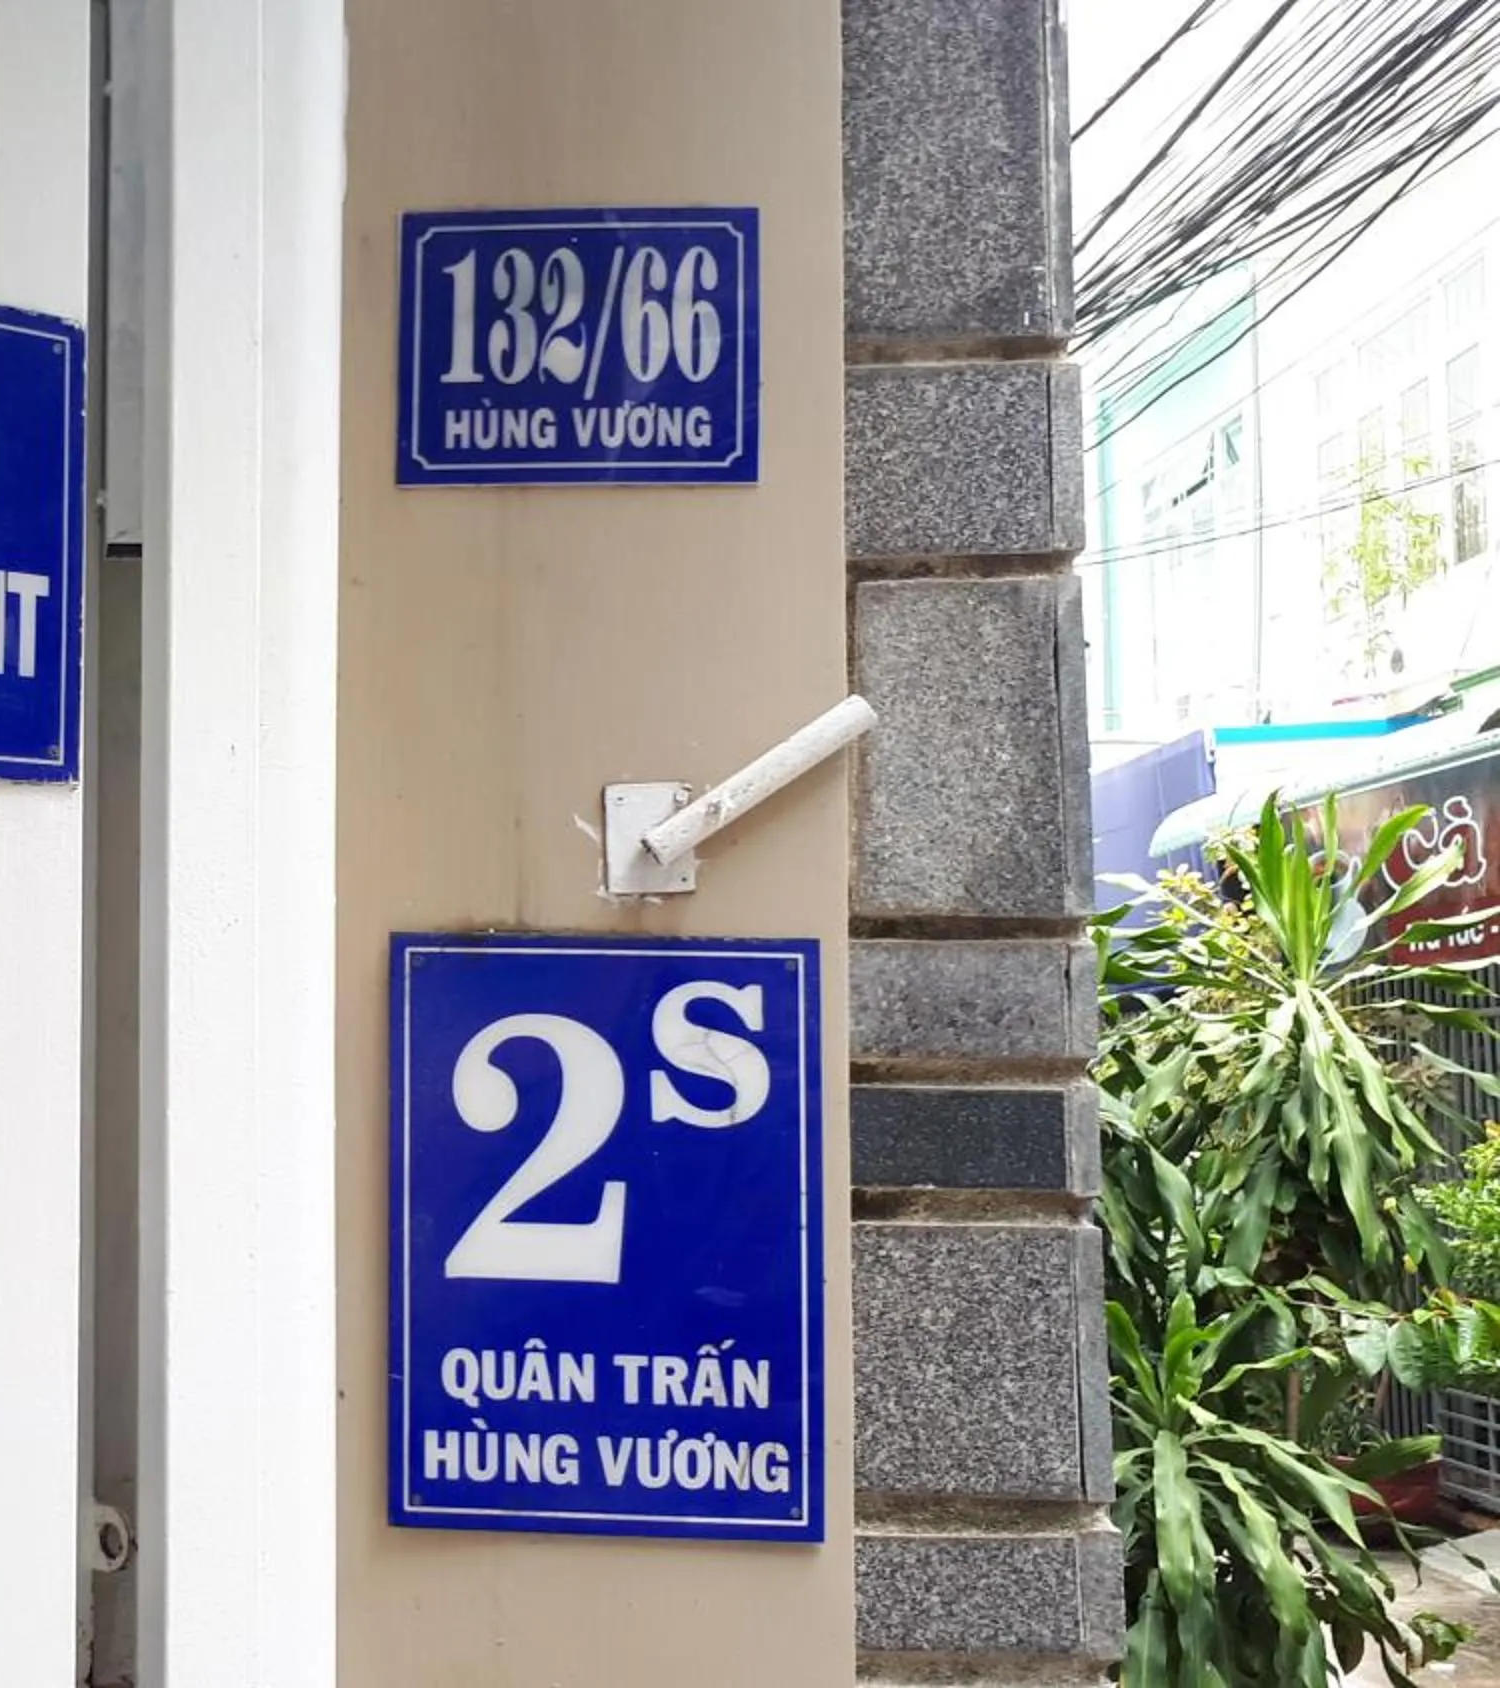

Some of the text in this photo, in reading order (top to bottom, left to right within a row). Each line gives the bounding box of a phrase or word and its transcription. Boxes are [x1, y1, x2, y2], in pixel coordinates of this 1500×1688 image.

[441, 246, 721, 400] 132/66
[446, 398, 711, 449] HÙNG VƯƠNG
[442, 1338, 769, 1408] QUÂN TRẤN
[424, 1418, 789, 1492] HÙNG VƯƠNG
